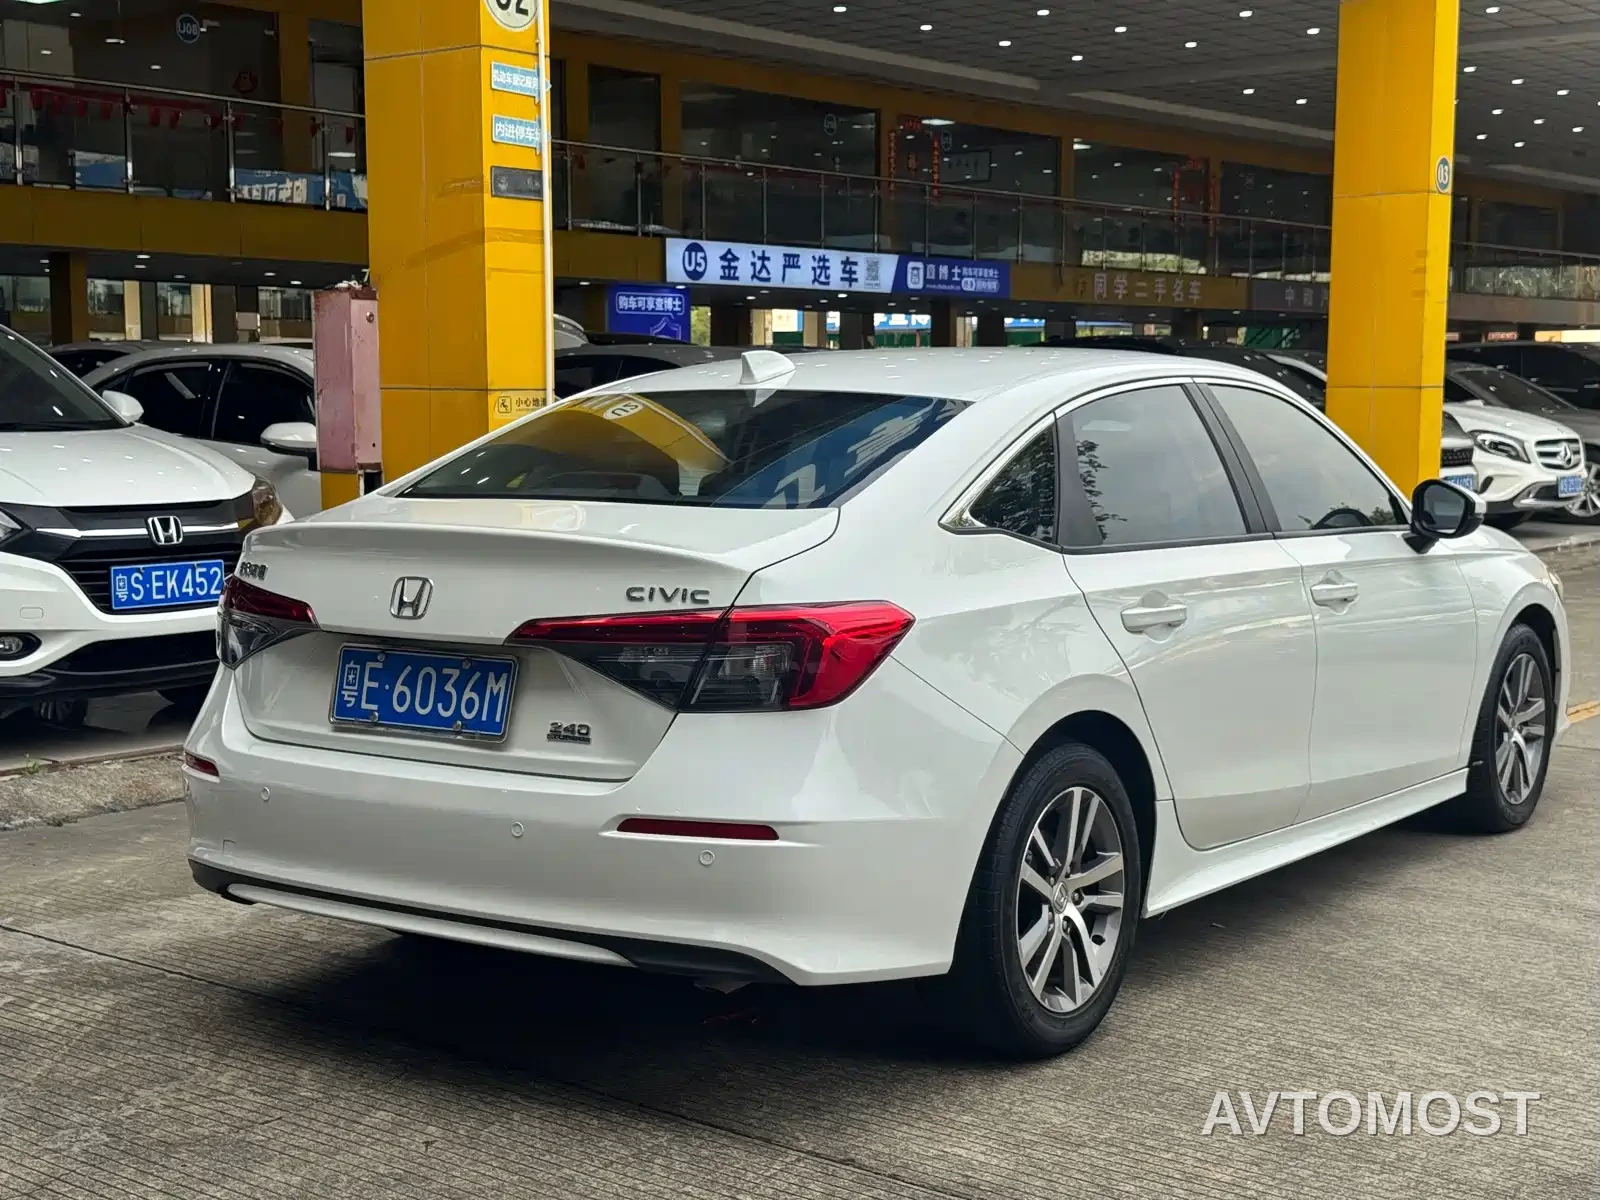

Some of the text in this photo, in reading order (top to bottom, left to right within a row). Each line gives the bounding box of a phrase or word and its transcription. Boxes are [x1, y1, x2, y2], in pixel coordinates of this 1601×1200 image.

[719, 247, 858, 288] 金达严选车
[618, 295, 682, 311] 购车可享查博士
[625, 586, 710, 604] CIVIC
[341, 653, 508, 723] 粤E·6036M
[549, 722, 590, 736] 240
